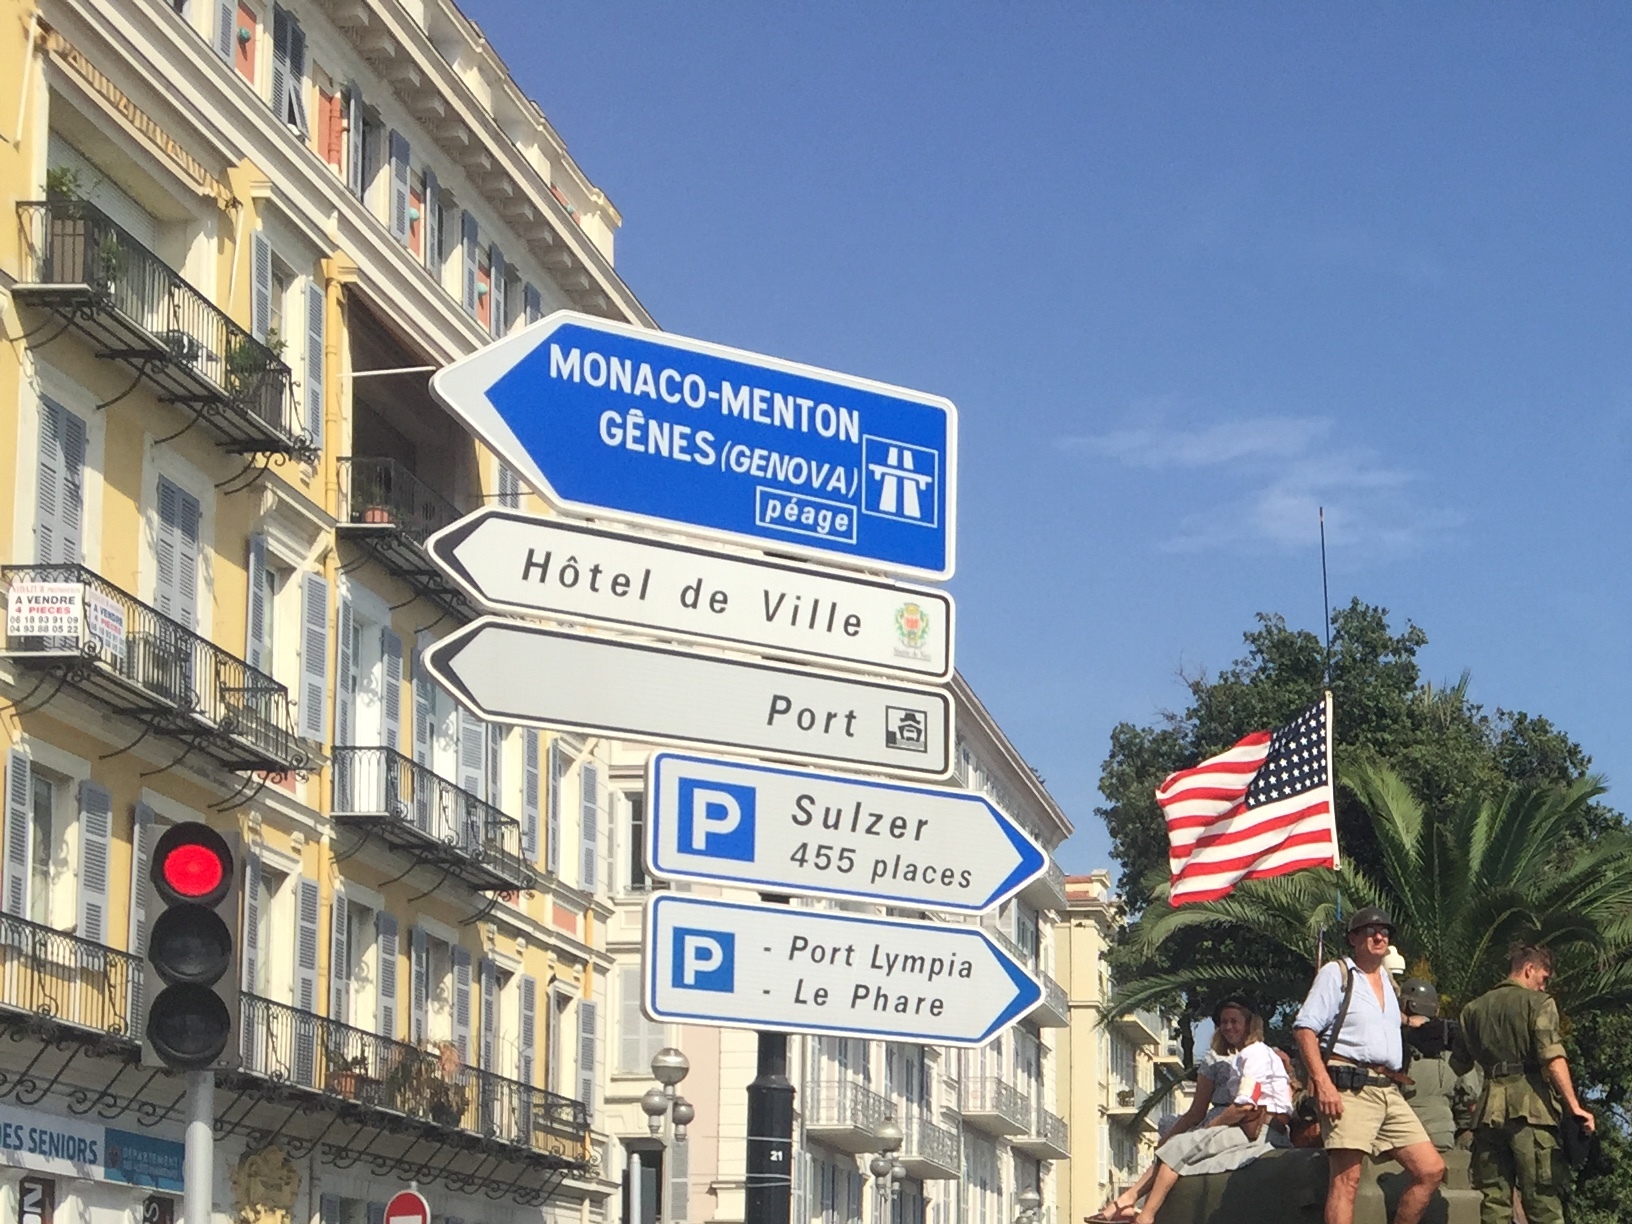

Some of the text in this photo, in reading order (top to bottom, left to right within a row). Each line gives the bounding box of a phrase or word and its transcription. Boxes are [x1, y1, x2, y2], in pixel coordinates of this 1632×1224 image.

[550, 343, 860, 444] MONACO-MENTON
[600, 409, 859, 498] GÊNES (GENOVA)
[765, 498, 849, 534] péage
[15, 595, 76, 605] A VENDRE
[29, 606, 71, 614] PIECES
[521, 548, 862, 637] Hôtel de Ville
[766, 694, 857, 737] Port
[691, 787, 741, 851] P
[791, 794, 929, 842] Sulzer
[789, 842, 972, 889] 455 places
[682, 934, 723, 985] P
[788, 935, 855, 967] Port
[870, 944, 973, 982] Lympia
[793, 978, 829, 1006] Le
[850, 984, 945, 1017] Phare
[0, 1122, 98, 1165] ES SENIORS
[769, 1150, 783, 1161] 21
